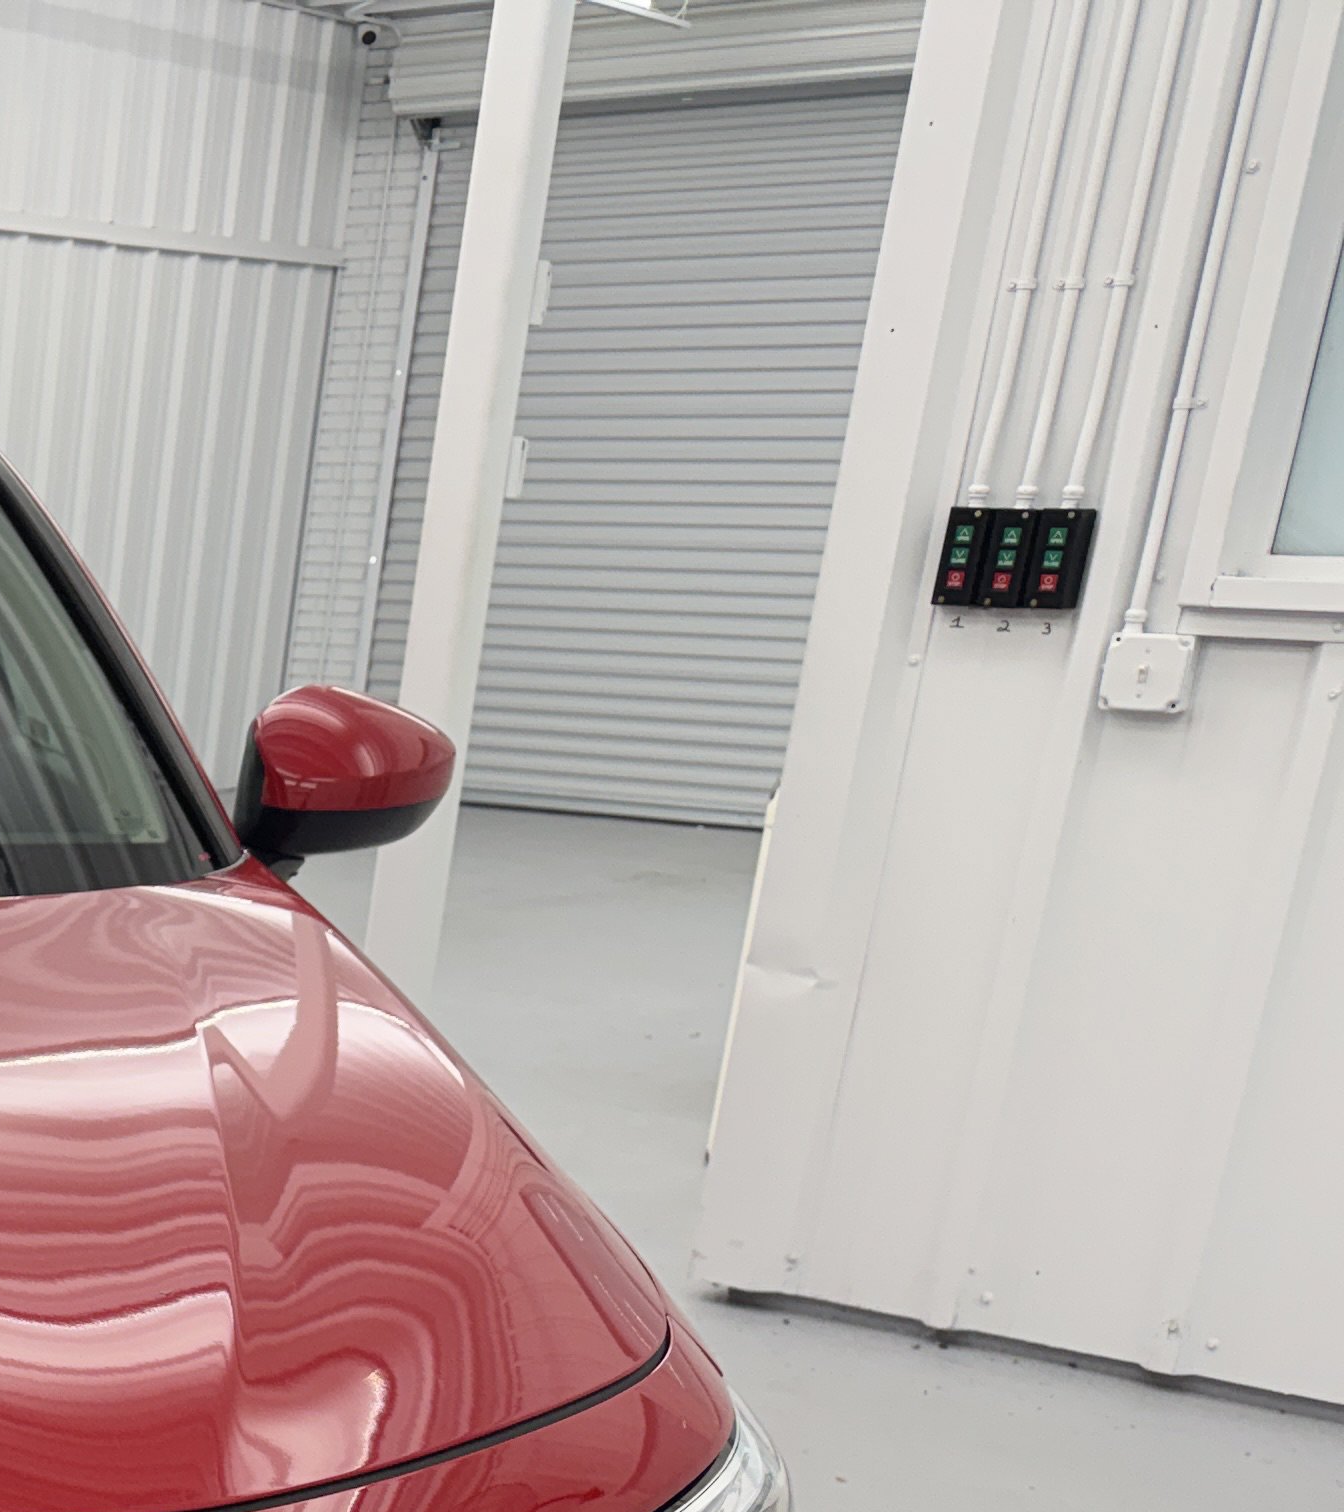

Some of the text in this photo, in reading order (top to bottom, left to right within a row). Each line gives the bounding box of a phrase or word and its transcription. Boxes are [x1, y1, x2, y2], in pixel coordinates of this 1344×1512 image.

[950, 616, 964, 628] 1
[997, 620, 1011, 632] 2
[1041, 622, 1052, 635] 3
